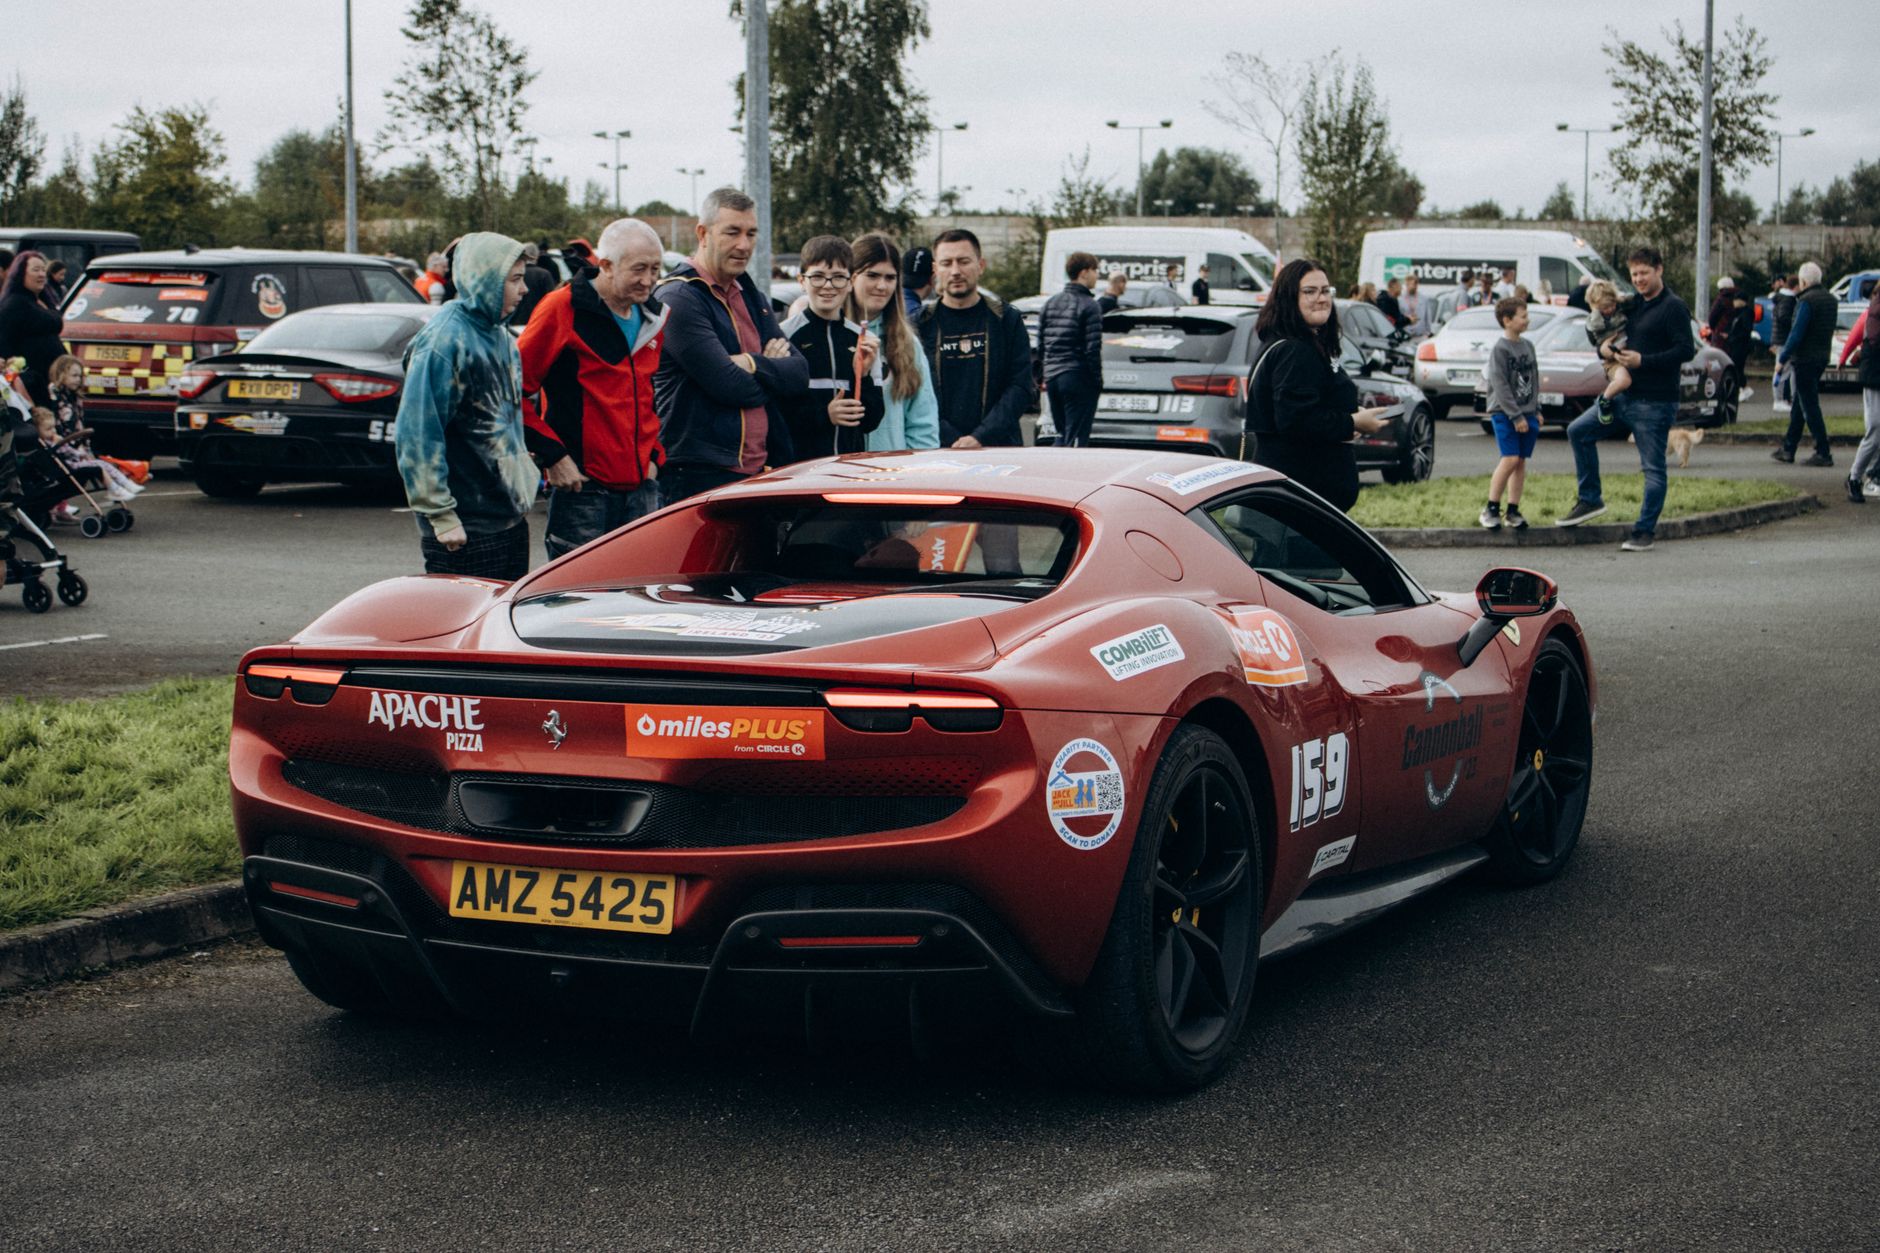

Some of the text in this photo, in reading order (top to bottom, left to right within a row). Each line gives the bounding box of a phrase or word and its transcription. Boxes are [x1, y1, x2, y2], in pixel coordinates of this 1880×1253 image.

[1099, 259, 1184, 279] terprise
[166, 306, 199, 323] 70
[96, 347, 130, 360] TISSUE
[1162, 394, 1196, 413] 113
[1112, 648, 1179, 677] LIFTING INNOVATION
[368, 691, 484, 732] APACHE
[446, 732, 483, 752] PIZZA
[1402, 704, 1484, 770] Cannonball
[734, 745, 754, 753] from
[756, 745, 790, 753] CIRCLE
[1055, 741, 1113, 768] CHARITY PARTNER
[1290, 732, 1350, 833] 159
[1053, 789, 1071, 800] JACK
[1059, 799, 1074, 808] JILL
[1059, 822, 1117, 848] SCAN TO DONATE
[1321, 844, 1350, 862] CAPITAL
[456, 866, 667, 925] AMZ 5425
